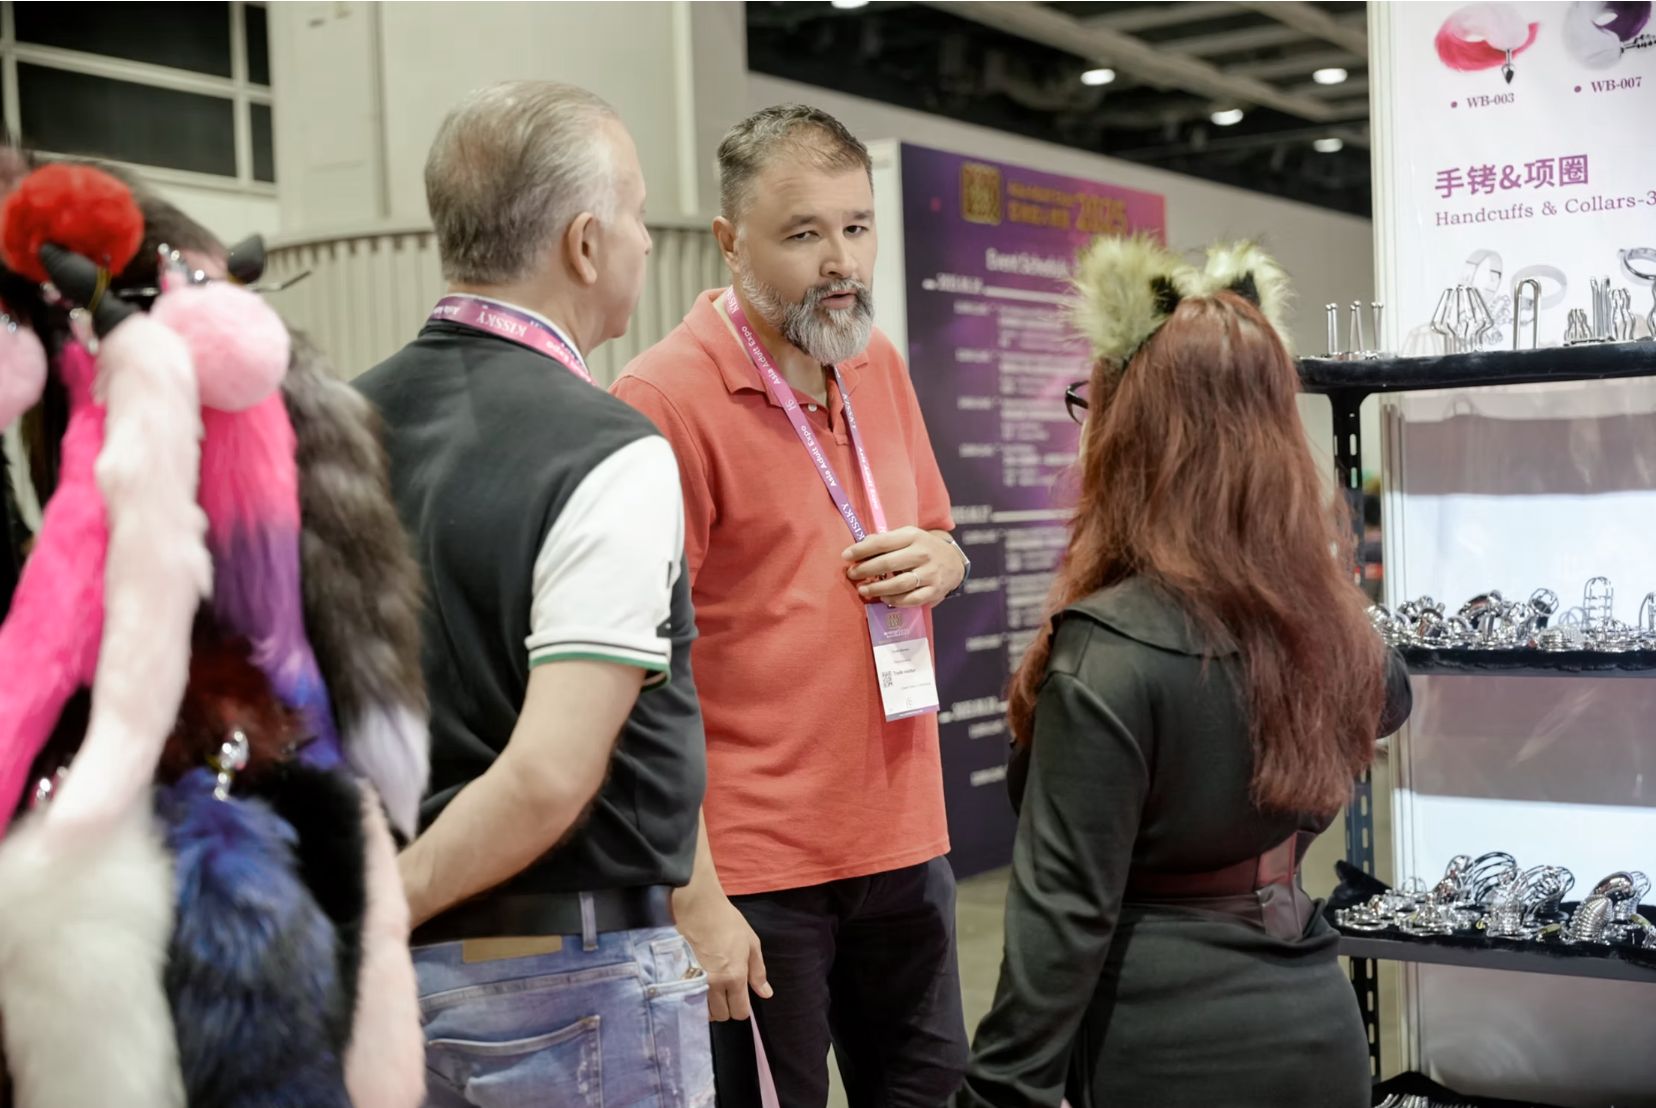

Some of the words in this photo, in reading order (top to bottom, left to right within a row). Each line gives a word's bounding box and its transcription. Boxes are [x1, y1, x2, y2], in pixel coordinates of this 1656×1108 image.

[1591, 76, 1643, 93] WB-007
[1466, 92, 1516, 109] WB-003
[1434, 154, 1589, 199] 手铐&项圈
[1435, 202, 1534, 226] Handcuffs
[1541, 201, 1558, 217] &
[476, 310, 528, 337] KISSKY
[741, 325, 756, 347] Expo
[752, 346, 770, 368] Adult
[767, 368, 781, 385] Asia
[801, 425, 815, 447] Expo
[812, 446, 828, 469] Adult
[825, 470, 837, 487] Asia
[841, 503, 866, 541] KISSKY
